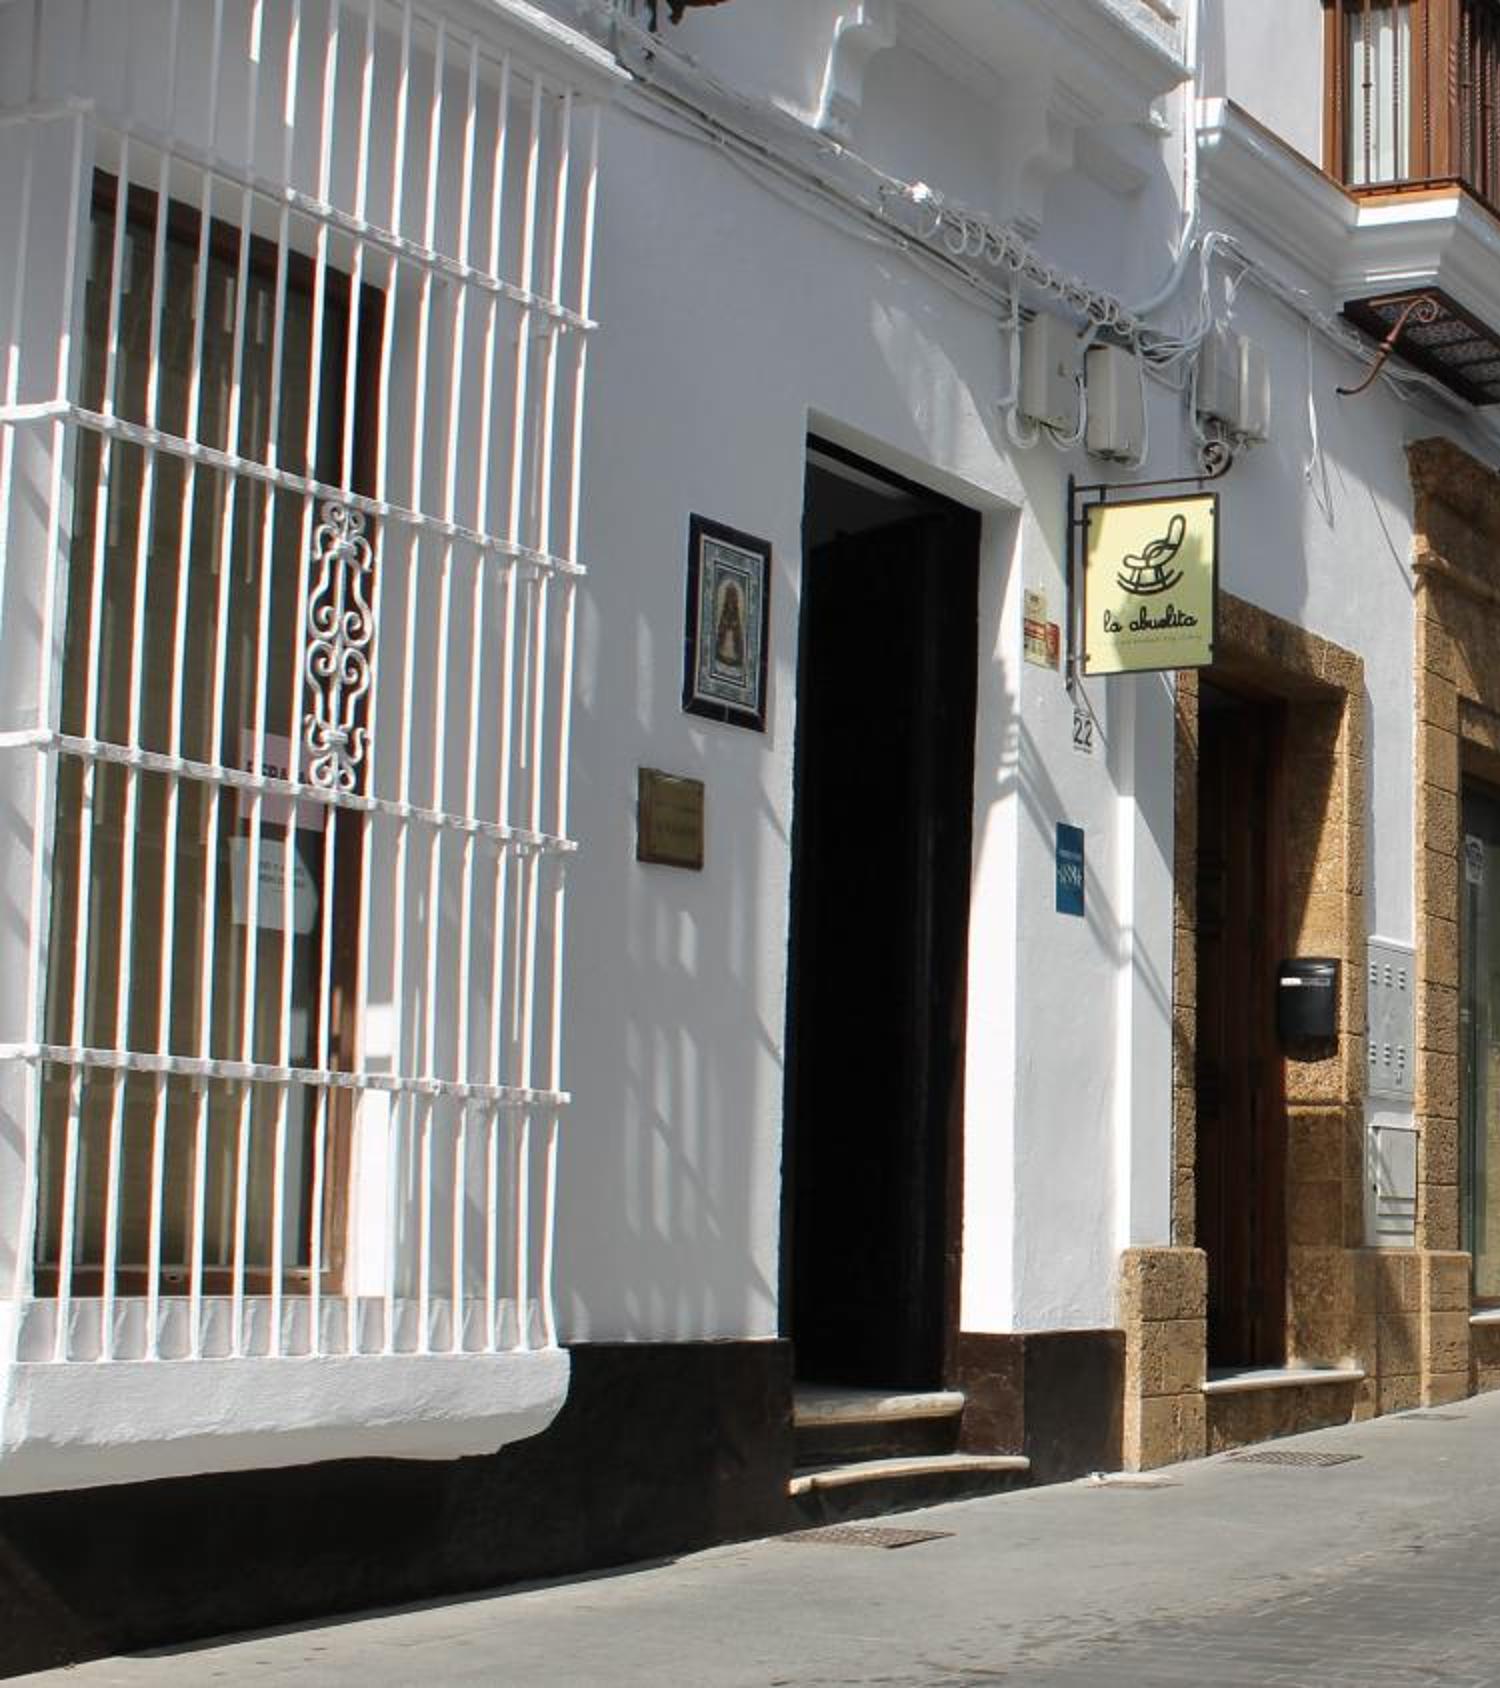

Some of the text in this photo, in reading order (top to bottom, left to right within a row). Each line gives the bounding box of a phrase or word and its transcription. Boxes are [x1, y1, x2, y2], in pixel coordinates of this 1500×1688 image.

[1103, 603, 1199, 633] la abuelita
[1074, 717, 1092, 747] 22
